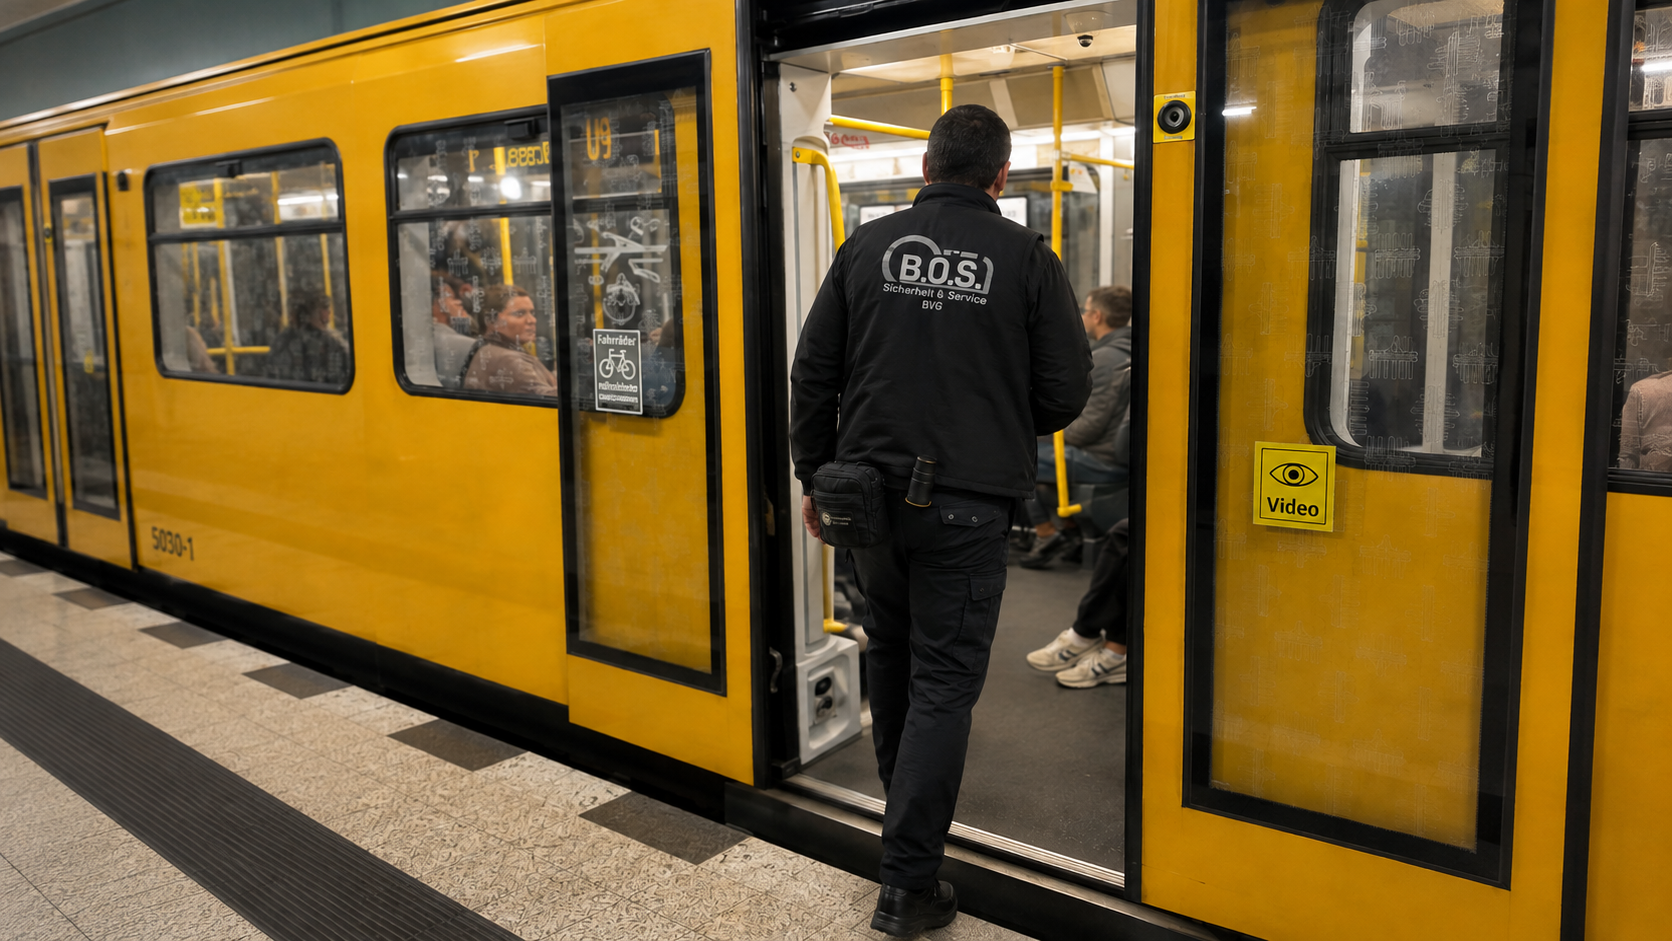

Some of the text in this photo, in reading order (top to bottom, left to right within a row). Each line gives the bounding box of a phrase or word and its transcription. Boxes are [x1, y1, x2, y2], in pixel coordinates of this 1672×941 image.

[586, 116, 612, 161] U9
[900, 253, 982, 289] B.O.S.
[921, 299, 943, 311] BVG
[947, 290, 988, 305] Service
[1266, 496, 1319, 517] Video
[151, 526, 195, 561] 5030-1
